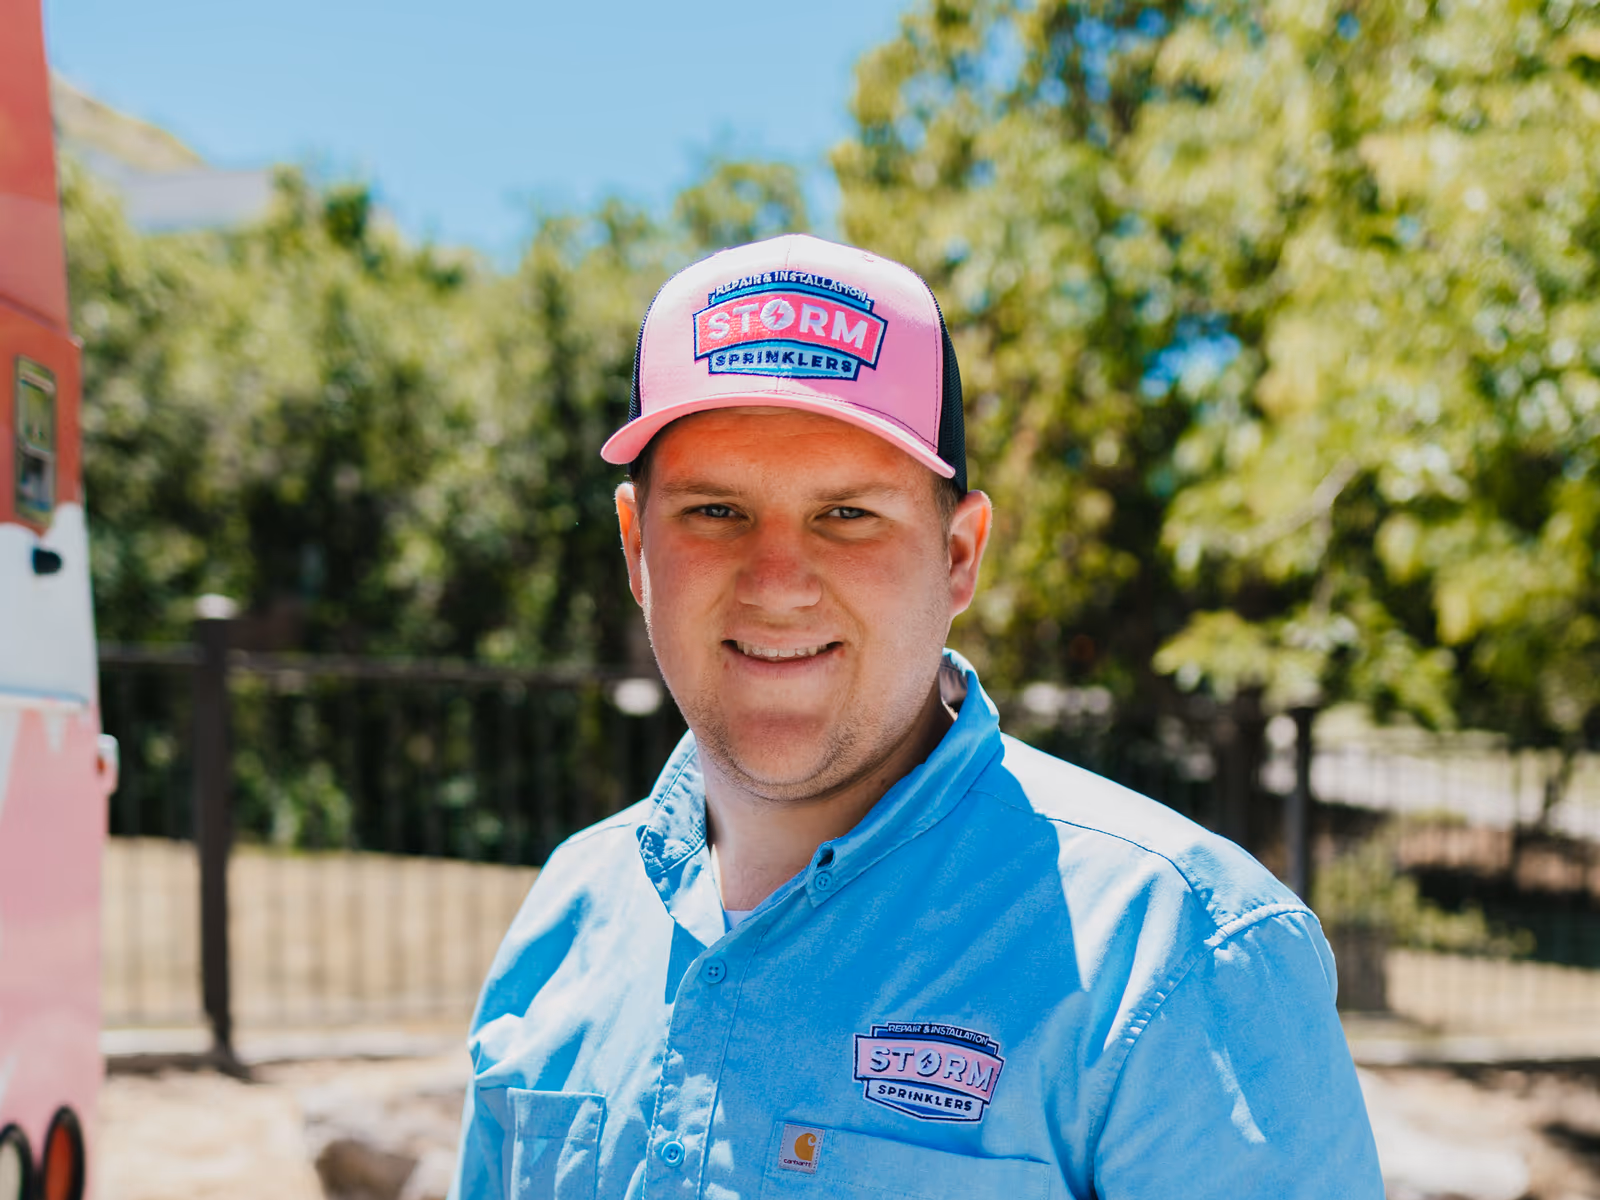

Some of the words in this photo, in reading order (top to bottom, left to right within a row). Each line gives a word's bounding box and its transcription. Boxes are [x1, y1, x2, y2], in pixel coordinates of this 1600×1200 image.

[715, 274, 761, 296] REPAIR
[762, 273, 772, 283] &
[774, 271, 867, 302] INSTALLATION
[708, 298, 868, 350] STORM
[715, 350, 852, 373] SPRINKLERS
[888, 1024, 922, 1033] REPAIR
[923, 1025, 931, 1034] &
[931, 1025, 989, 1045] INSTALLATION
[870, 1046, 994, 1092] STORM
[877, 1084, 973, 1112] SPRINKLERS
